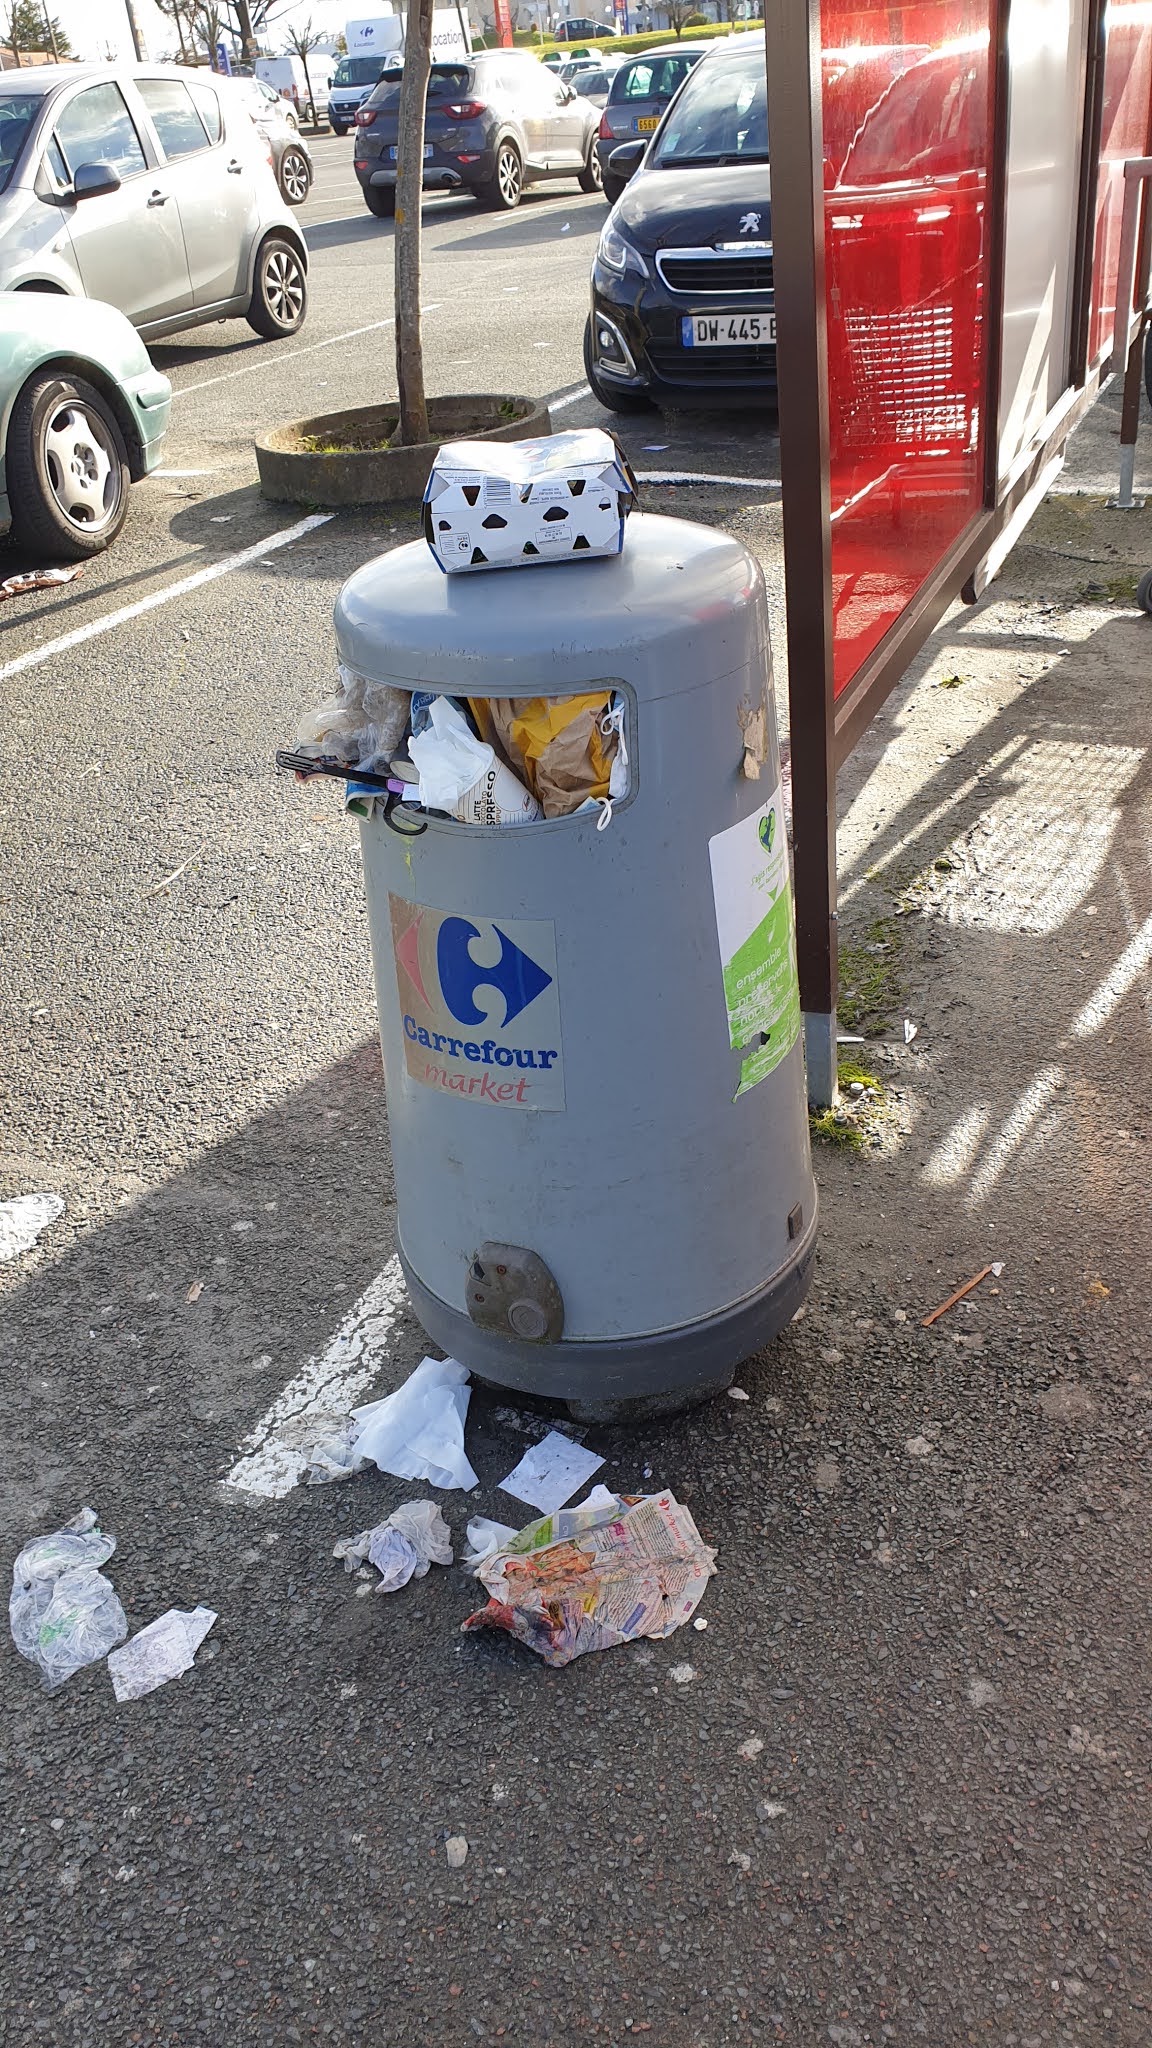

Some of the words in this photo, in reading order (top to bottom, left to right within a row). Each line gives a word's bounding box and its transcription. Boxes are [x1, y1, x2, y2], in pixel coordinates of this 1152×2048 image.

[432, 28, 463, 46] ocation
[473, 800, 482, 821] LATTE
[486, 770, 496, 826] SPRESSO
[736, 947, 782, 989] ensemble
[403, 1014, 558, 1069] Carrefour
[424, 1063, 533, 1103] market
